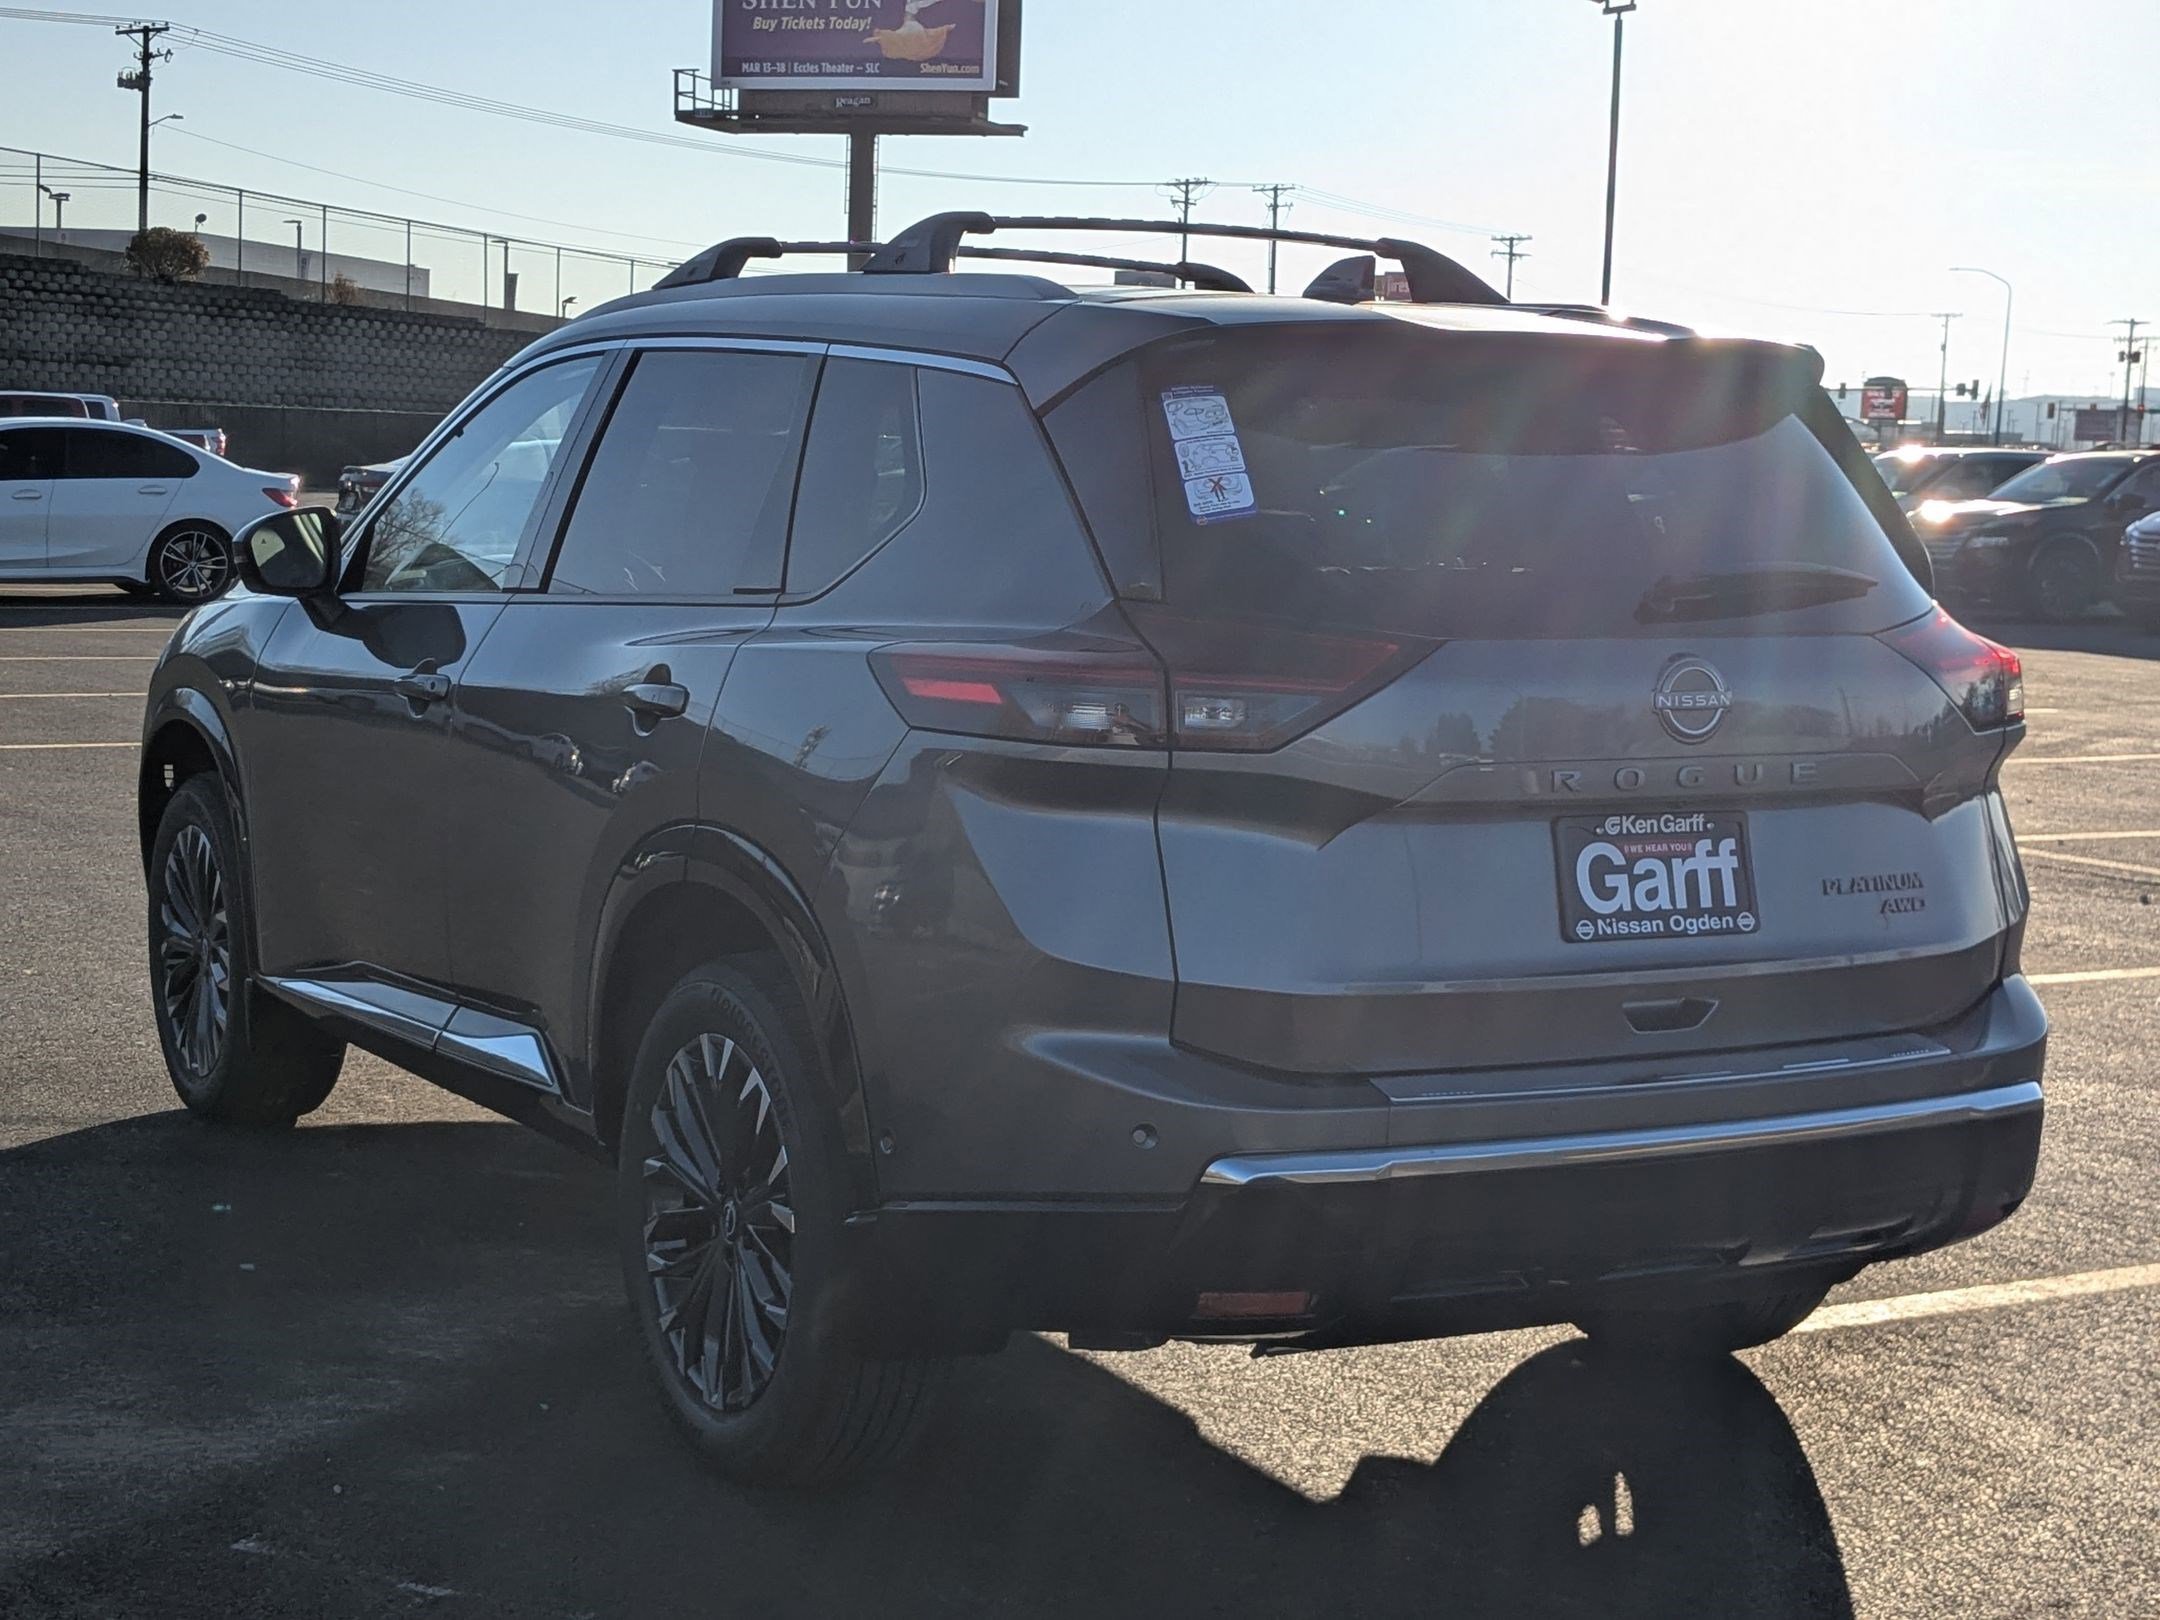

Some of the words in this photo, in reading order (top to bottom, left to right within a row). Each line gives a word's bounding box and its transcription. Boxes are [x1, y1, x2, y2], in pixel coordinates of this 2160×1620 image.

[753, 16, 778, 32] Buy
[781, 16, 825, 30] Tickets
[829, 16, 872, 32] Today!
[742, 62, 760, 73] MAR
[793, 62, 819, 73] Eccles
[821, 62, 854, 73] Theater
[865, 63, 880, 73] SLC
[920, 63, 980, 74] ShenYun.com
[1658, 694, 1731, 707] NISSAN
[1551, 762, 1818, 793] ROGUE
[1622, 817, 1658, 834] Ken
[1660, 814, 1705, 833] Garff
[1630, 844, 1643, 853] WE
[1645, 843, 1669, 852] HEAR
[1670, 842, 1687, 852] YOU
[1576, 838, 1739, 915] Garff
[1821, 872, 1924, 896] PLATINUM
[1880, 897, 1926, 914] AWD
[1597, 918, 1664, 935] Nissan
[1669, 914, 1734, 934] Ogden
